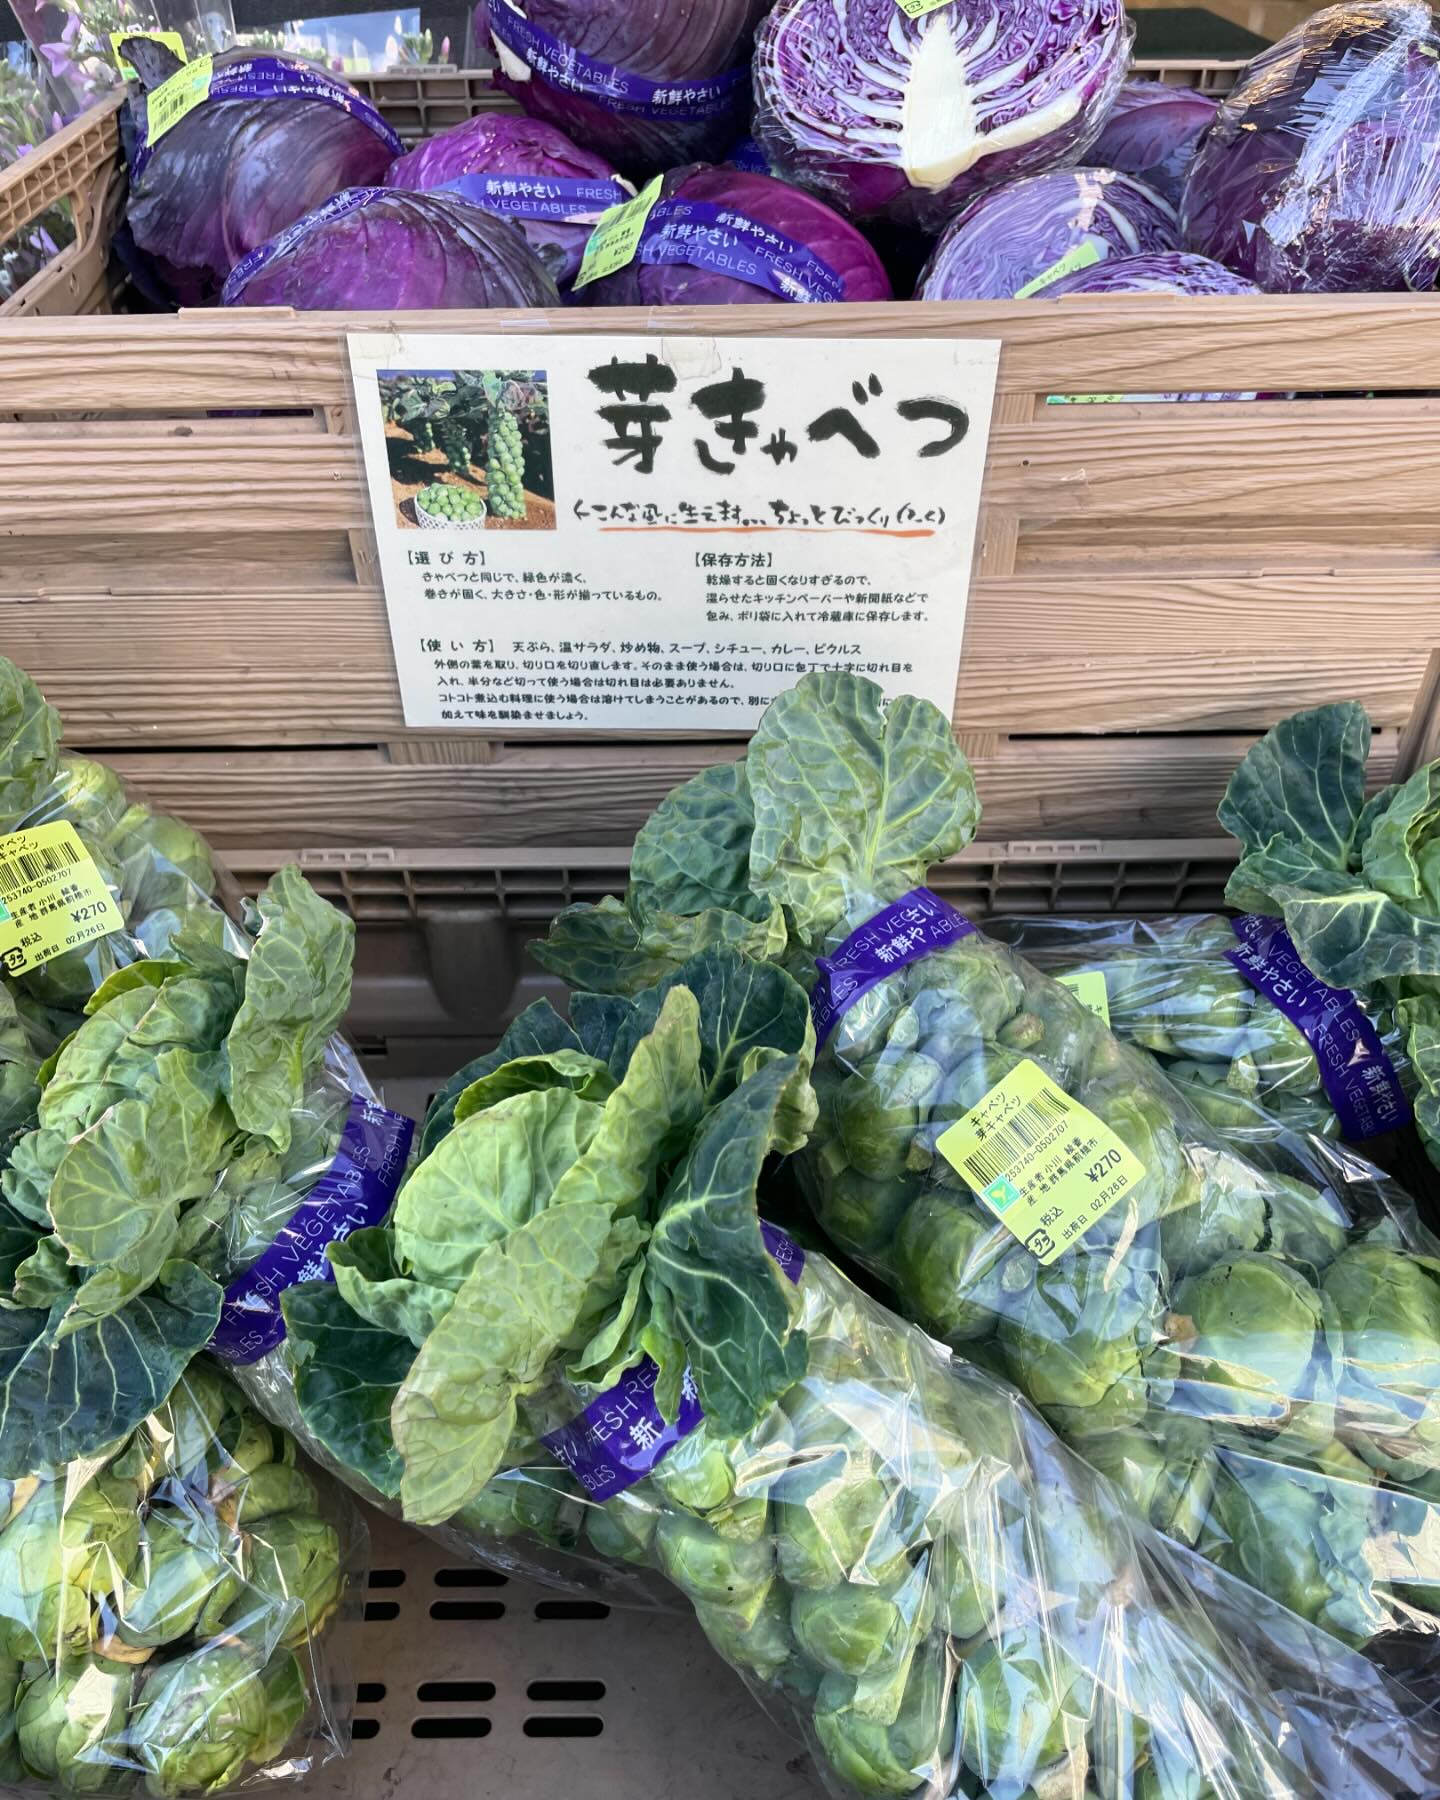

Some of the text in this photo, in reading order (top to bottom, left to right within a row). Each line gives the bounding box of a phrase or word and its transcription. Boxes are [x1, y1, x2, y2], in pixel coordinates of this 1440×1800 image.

[507, 15, 630, 94] FRESH VEGETABLES
[652, 86, 721, 106] 新鮮やさい
[485, 179, 561, 199] 新鮮やさい
[576, 187, 622, 200] FRESH
[490, 200, 587, 215] VEGETABLES
[660, 223, 739, 247] 新鮮やさい
[659, 245, 757, 276] VEGETABLES
[754, 246, 803, 281] FRESH
[586, 353, 970, 475] 芽きゃべつ
[694, 552, 773, 568] 【保存方法】
[70, 901, 108, 924] ¥270
[20, 932, 43, 949] 税込
[34, 923, 106, 962] 出荷日 02月26日
[1268, 943, 1362, 1042] VEGETABLES
[970, 1092, 1006, 1127] キャベツ
[974, 1095, 1021, 1142] 芽キャベツ
[1007, 1120, 1069, 1182] 253740-0502707
[1084, 1149, 1122, 1183] ¥270
[1020, 1172, 1043, 1197] 生産者
[282, 1145, 371, 1263] VEGETABLES
[1040, 1206, 1064, 1228] 税込
[1061, 1175, 1128, 1240] 出荷日 02月26日
